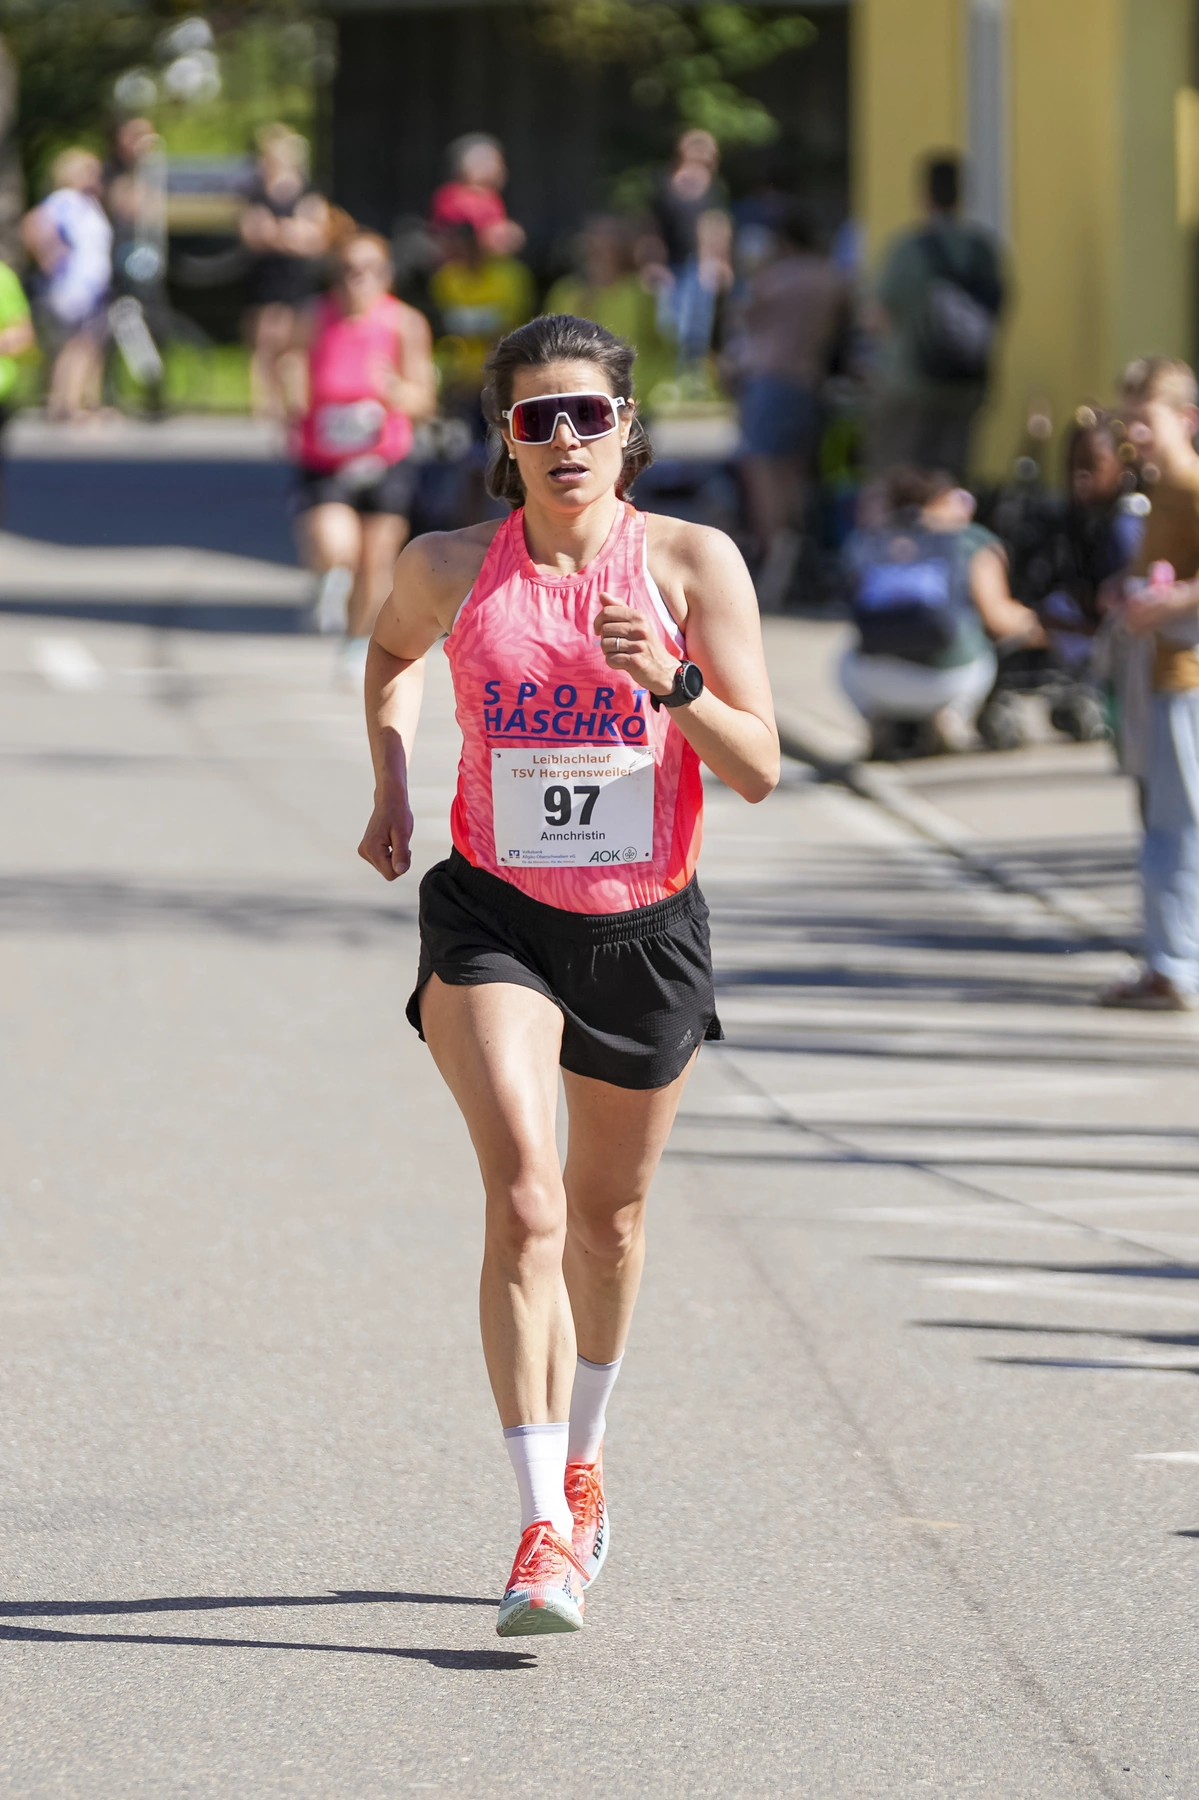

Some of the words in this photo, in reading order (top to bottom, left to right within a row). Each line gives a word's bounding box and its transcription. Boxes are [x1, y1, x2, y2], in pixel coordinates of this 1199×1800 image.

[483, 680, 648, 713] SPORT
[484, 707, 646, 738] HASCHKO
[533, 754, 611, 764] Leiblachlauf
[511, 769, 535, 778] TSV
[540, 767, 633, 780] Hergensweiler
[544, 785, 600, 826] 97
[540, 831, 606, 841] Annchristin
[589, 849, 620, 863] AOK
